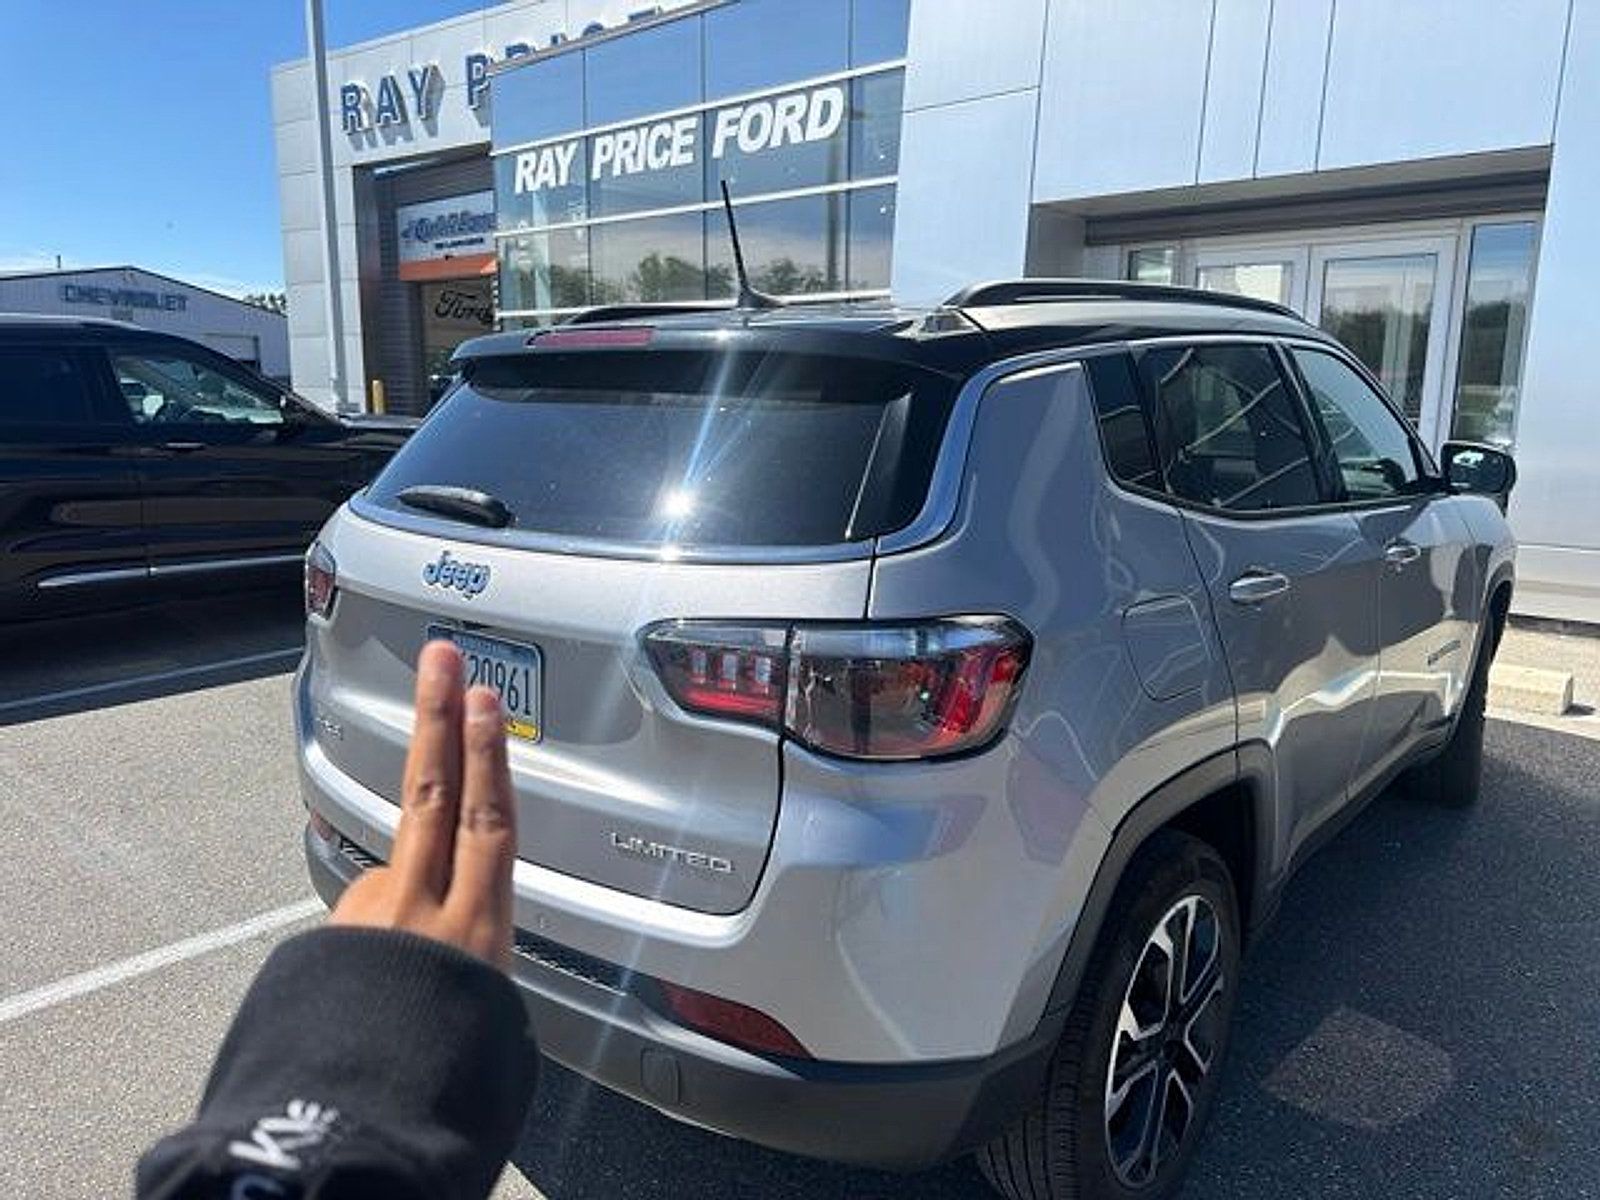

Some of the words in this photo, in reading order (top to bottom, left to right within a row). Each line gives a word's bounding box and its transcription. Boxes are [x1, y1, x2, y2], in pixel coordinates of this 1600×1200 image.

[340, 63, 434, 135] RAY
[514, 141, 580, 195] RAY
[590, 118, 699, 181] PRICE
[712, 86, 845, 159] FORD
[422, 550, 491, 601] Jeep
[610, 831, 733, 874] LIMITED
